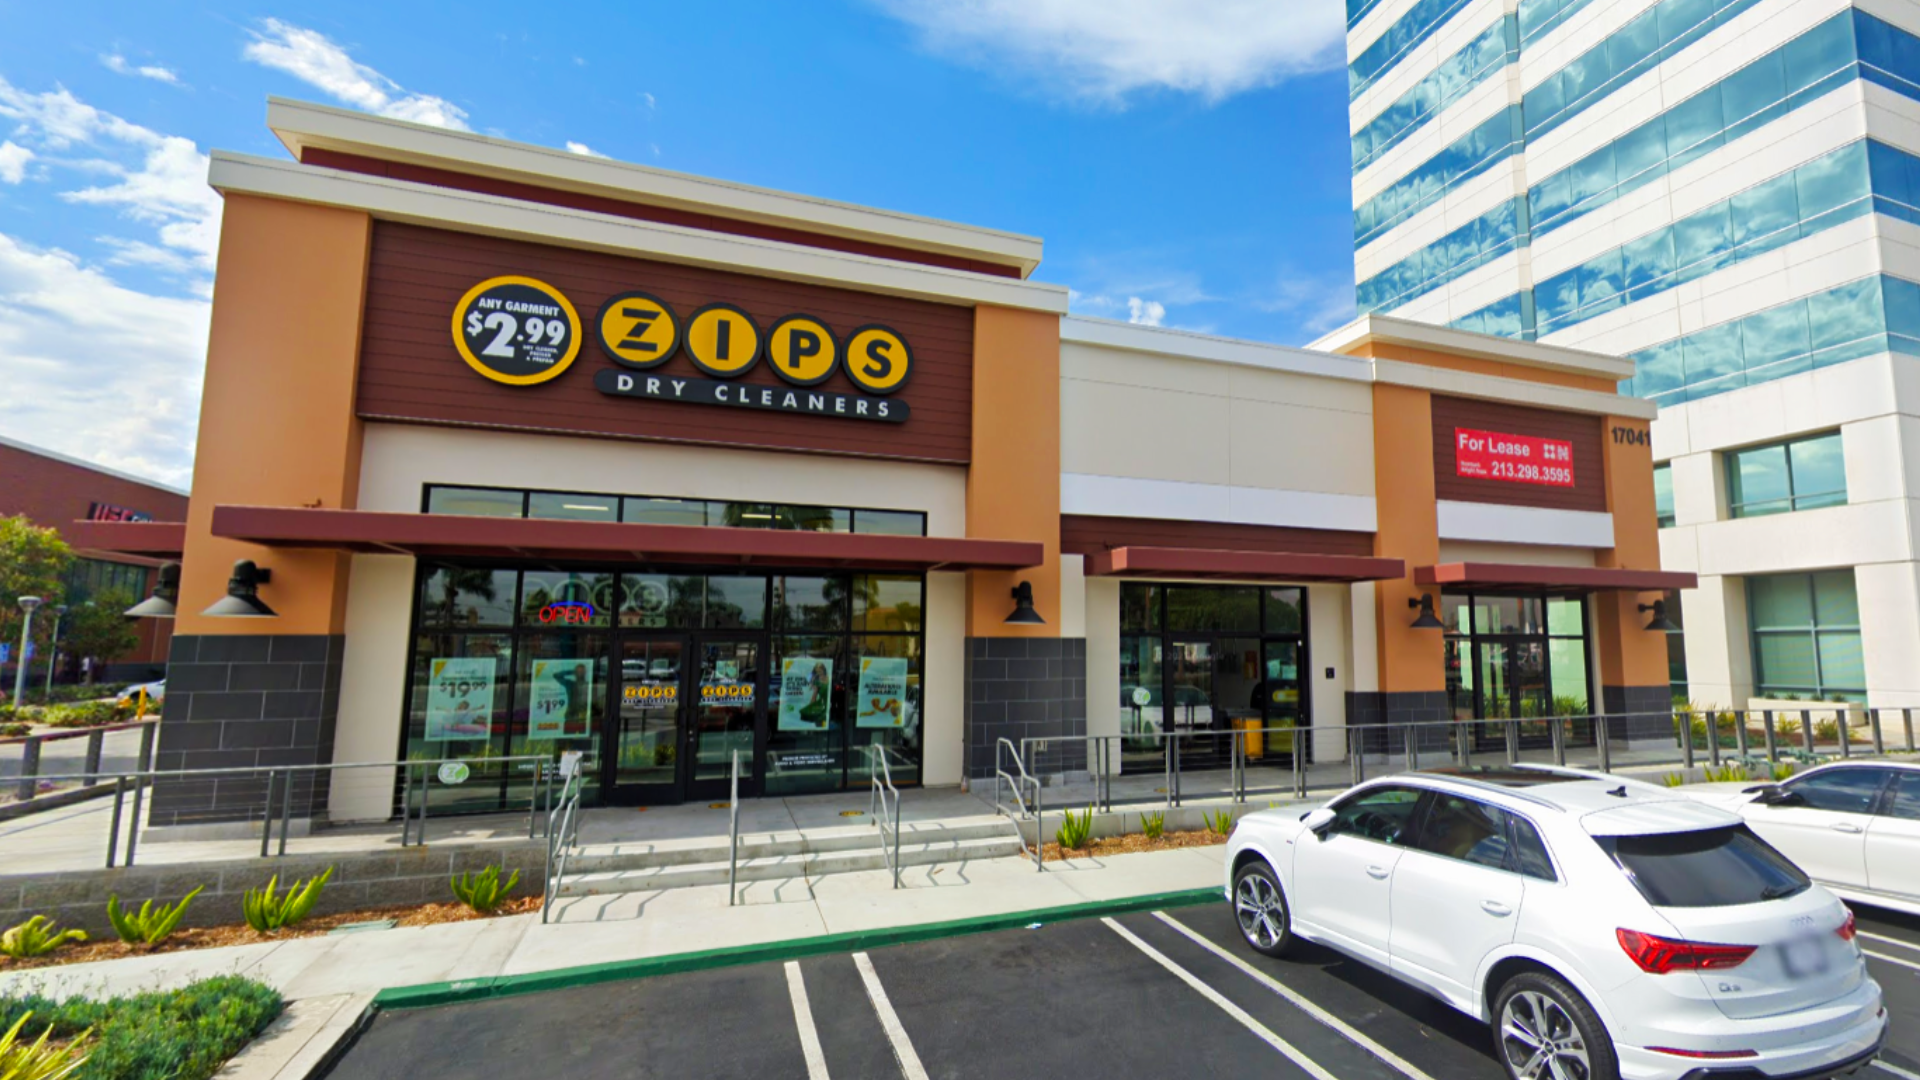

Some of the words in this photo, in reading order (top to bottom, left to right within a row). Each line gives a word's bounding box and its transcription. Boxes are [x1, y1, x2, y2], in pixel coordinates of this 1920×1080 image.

[478, 297, 502, 310] ANY
[505, 301, 560, 317] GARMENT
[466, 309, 566, 359] $2.99
[614, 305, 895, 381] ZIPS
[616, 374, 687, 397] DRY
[714, 384, 889, 417] CLEANERS
[1458, 433, 1485, 451] For
[1488, 436, 1531, 457] Lease
[1611, 426, 1651, 447] 17041
[1491, 460, 1571, 483] 213.298.3595
[538, 605, 591, 624] OPEN
[626, 687, 675, 698] ZIPS
[703, 685, 751, 697] ZIPS
